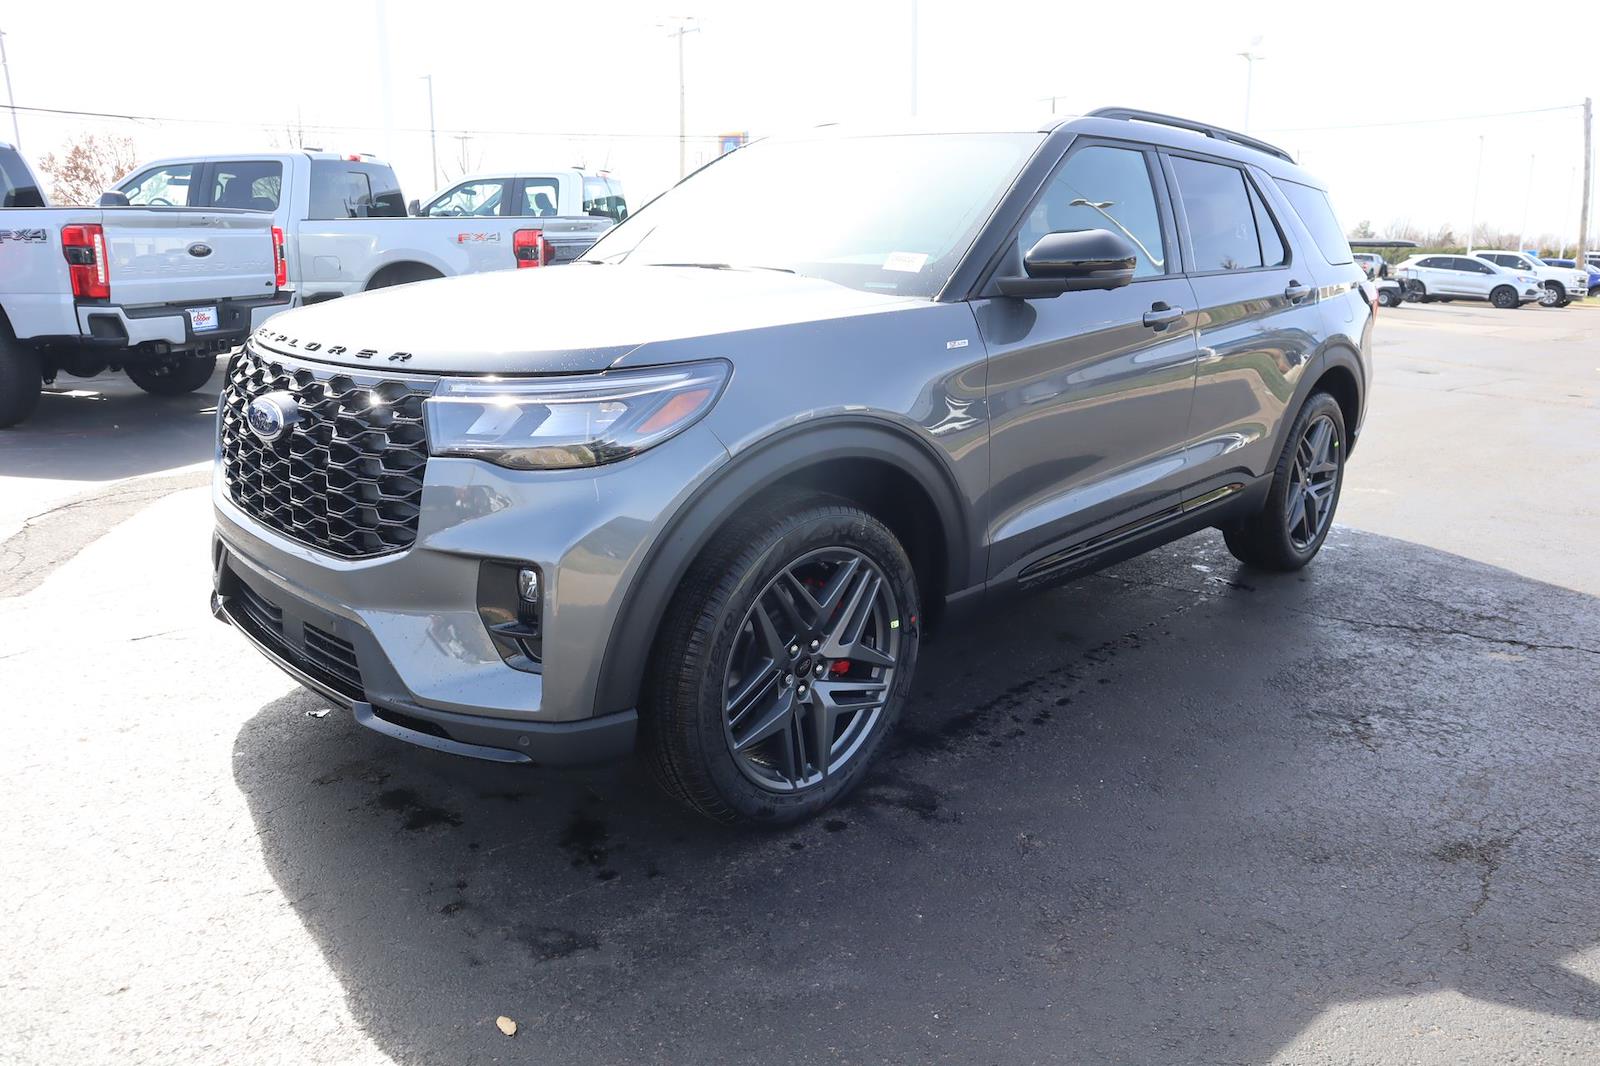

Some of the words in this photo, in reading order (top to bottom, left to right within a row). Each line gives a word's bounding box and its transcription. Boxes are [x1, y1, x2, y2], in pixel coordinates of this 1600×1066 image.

[0, 229, 47, 243] FX4
[457, 232, 501, 244] FX4
[259, 328, 413, 362] EXPLORER
